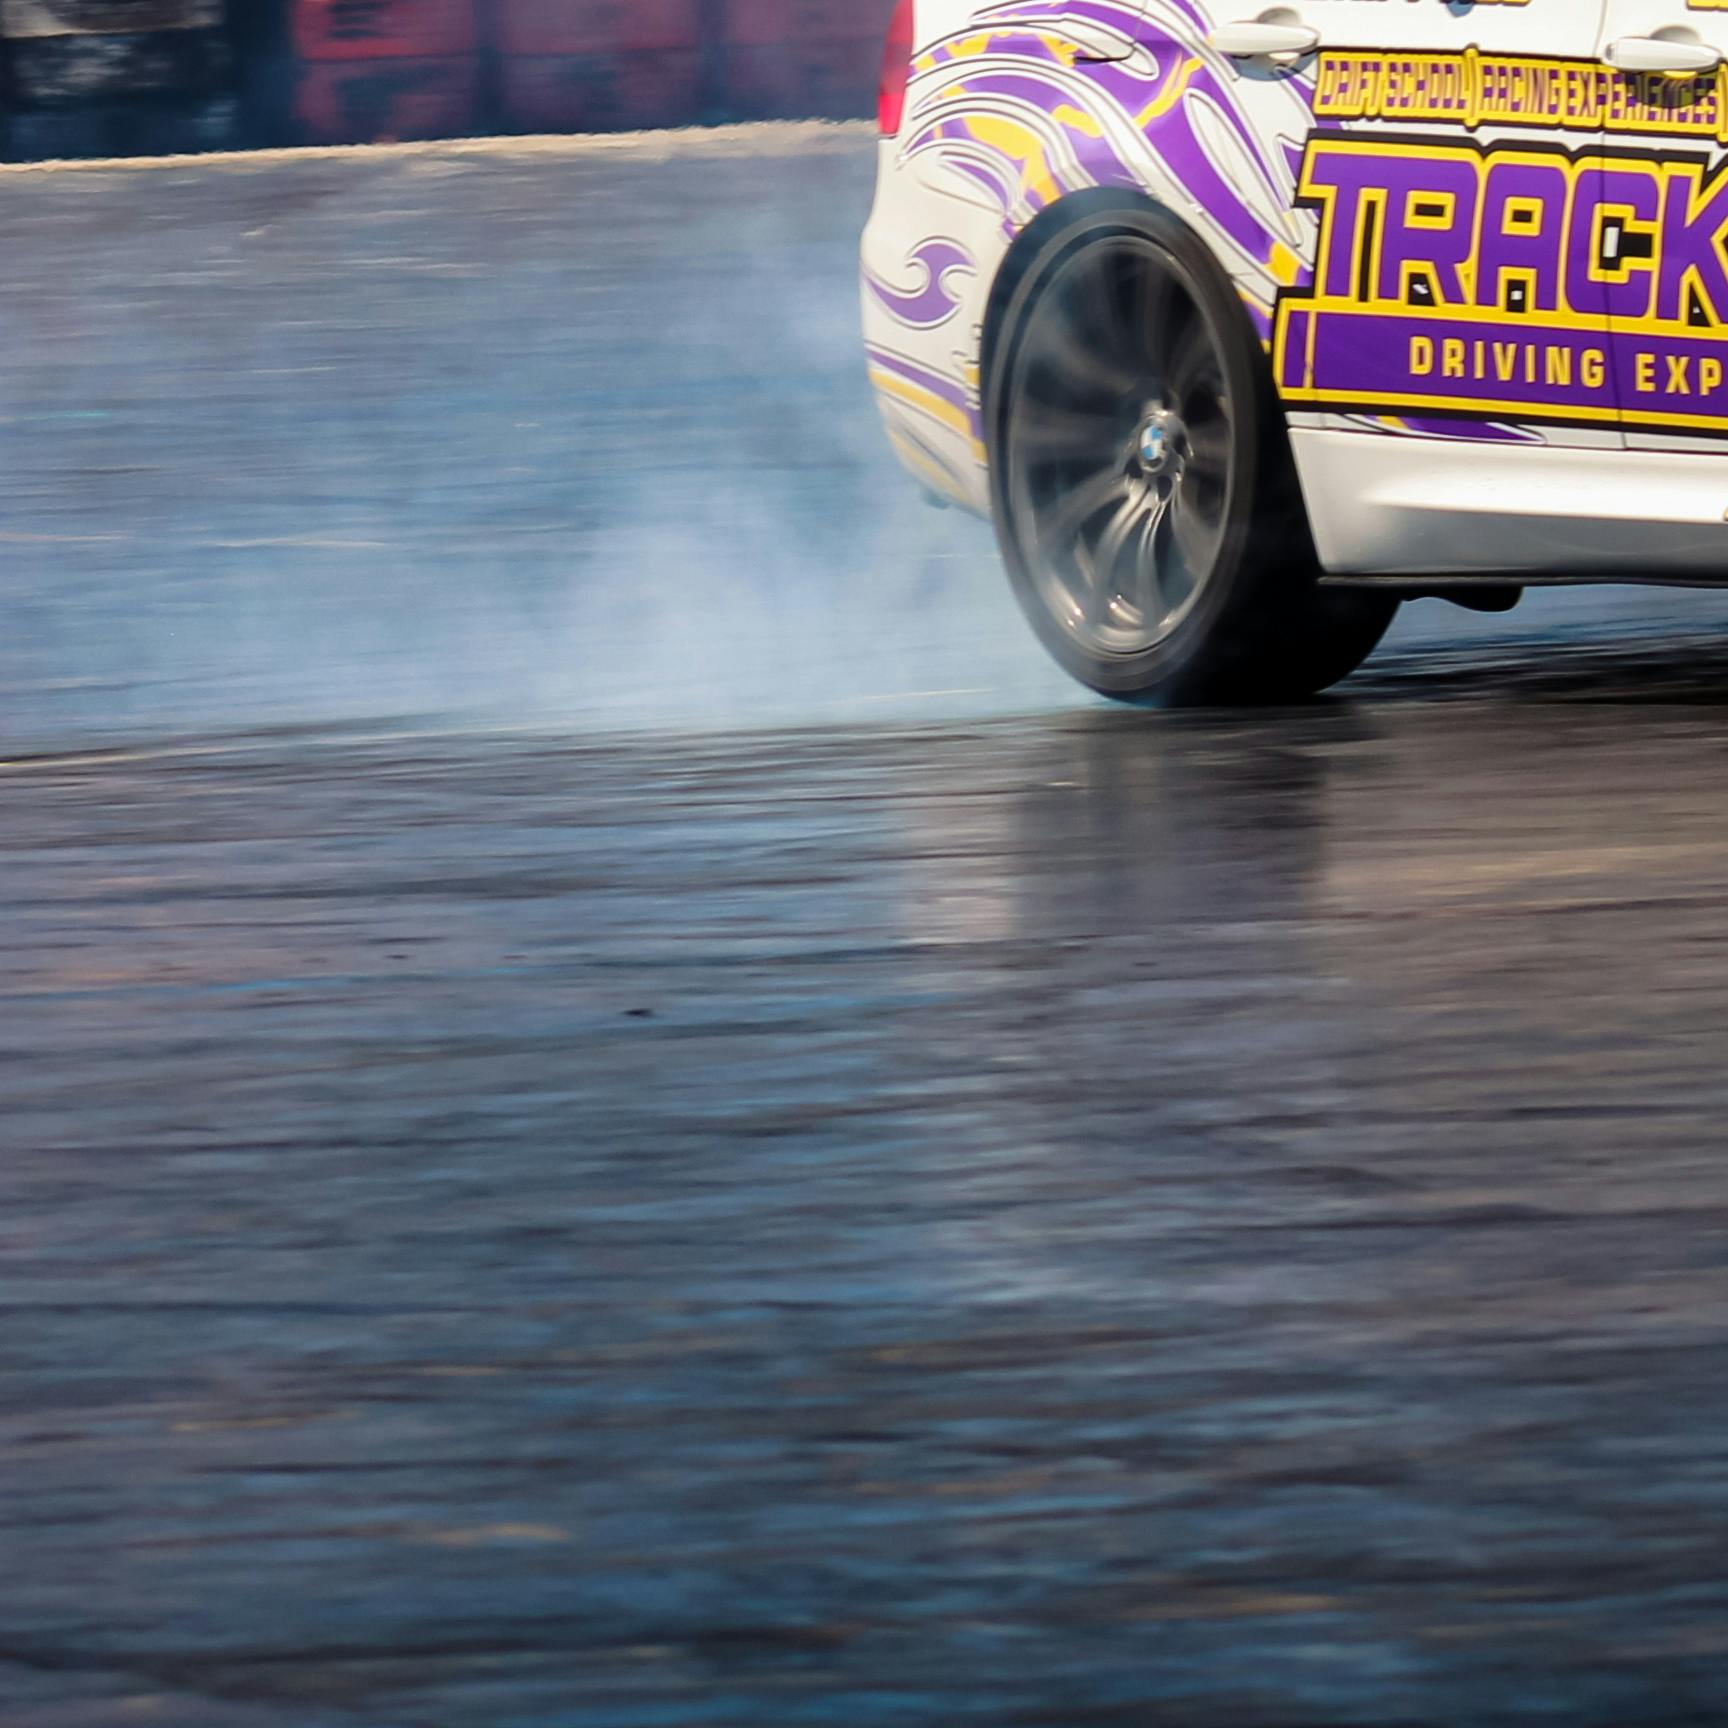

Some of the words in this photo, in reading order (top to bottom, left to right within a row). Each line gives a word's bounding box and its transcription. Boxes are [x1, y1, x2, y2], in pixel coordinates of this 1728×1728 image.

[1320, 59, 1383, 106] DRIFT
[1386, 60, 1468, 109] SCHOOL
[1482, 64, 1561, 116] RACING
[1566, 69, 1717, 125] EXPERIENCES
[1409, 335, 1606, 390] DRIVING
